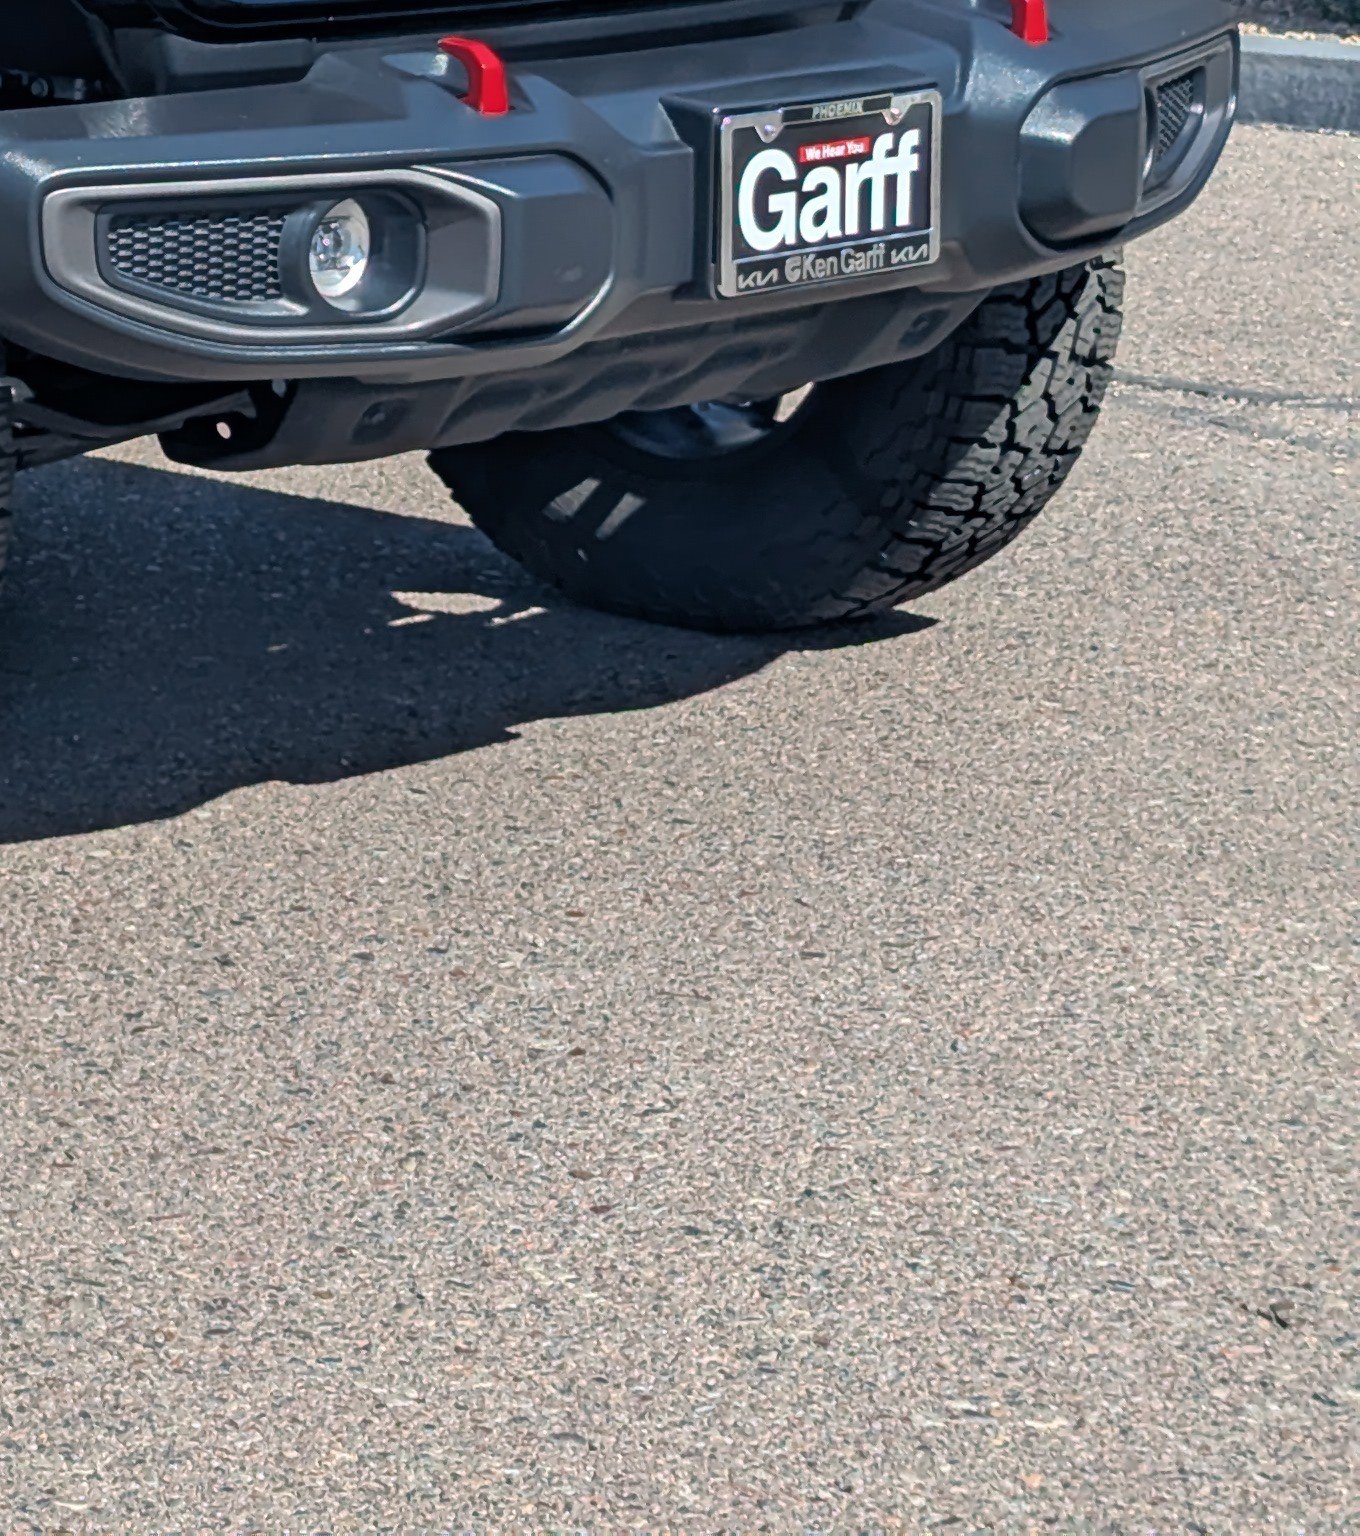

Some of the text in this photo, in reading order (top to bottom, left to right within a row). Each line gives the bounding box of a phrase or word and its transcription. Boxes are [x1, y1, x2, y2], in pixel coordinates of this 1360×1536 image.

[811, 101, 864, 120] PHOENIX
[805, 139, 865, 161] We Hear You
[738, 128, 920, 252] Garff
[802, 252, 839, 279] Ken
[840, 242, 886, 275] Garff
